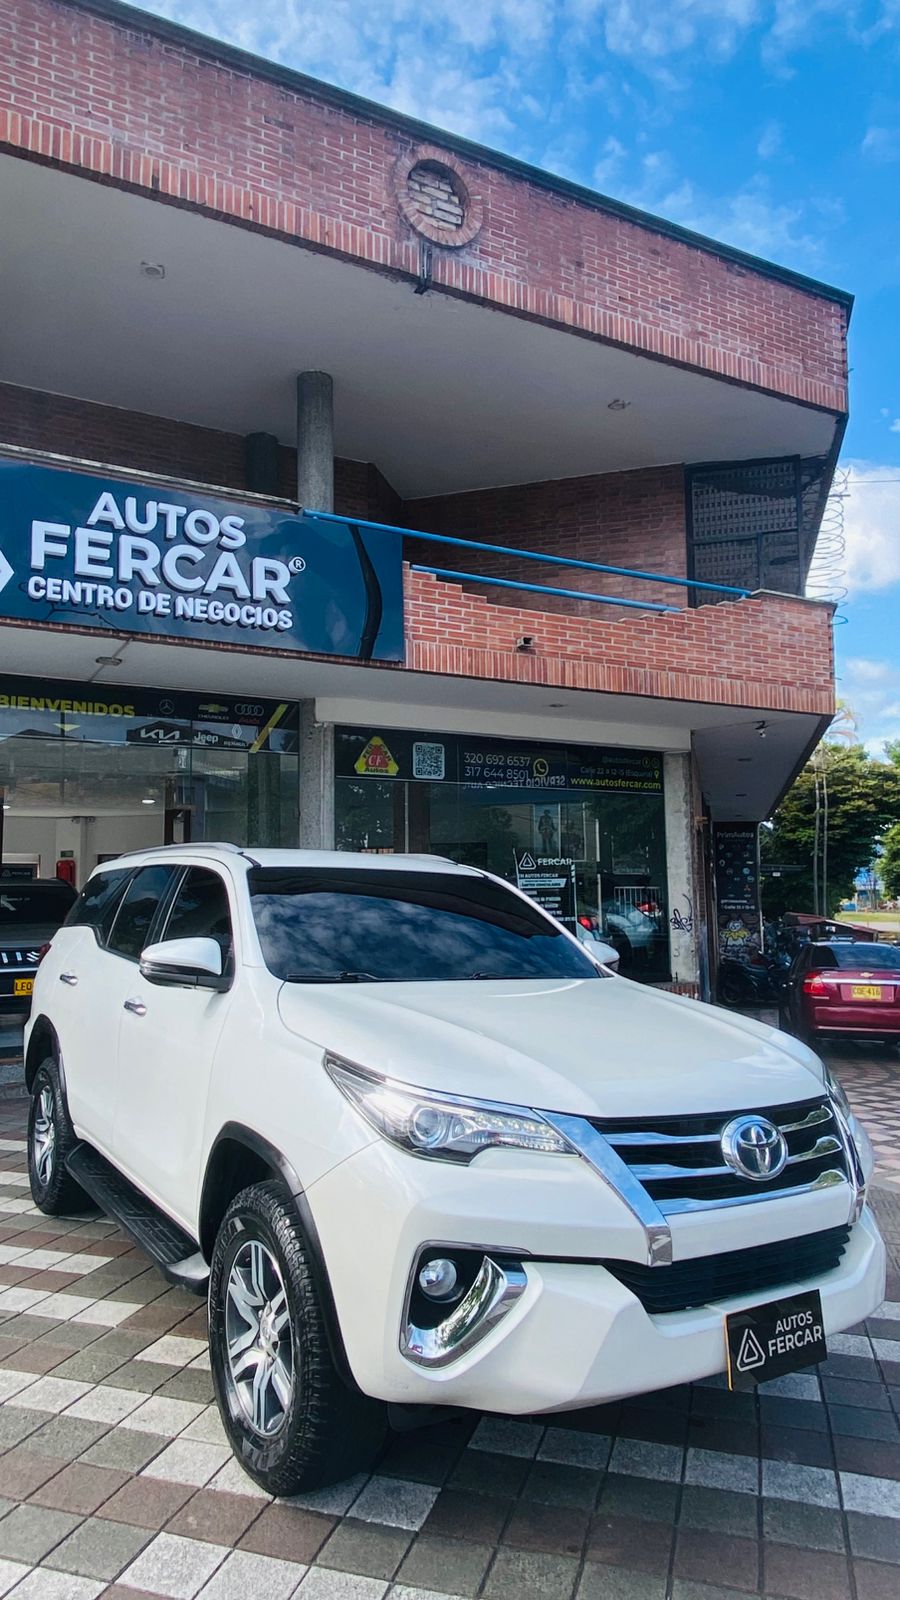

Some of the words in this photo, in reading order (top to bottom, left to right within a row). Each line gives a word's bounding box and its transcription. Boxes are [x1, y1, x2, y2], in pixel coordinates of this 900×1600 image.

[87, 491, 247, 550] AUTOS
[27, 575, 133, 609] CENTRO
[138, 590, 171, 614] DE
[175, 596, 293, 631] NEGOCIOS
[0, 694, 136, 719] BIENVENIDOS
[140, 728, 180, 740] KIA
[193, 731, 219, 744] Jeep
[463, 752, 483, 764] 320
[485, 754, 505, 766] 692
[507, 755, 531, 767] 6537
[464, 765, 481, 777] 317
[483, 767, 504, 778] 644
[506, 768, 529, 781] 8501
[570, 777, 661, 790] www.autosfercar.com
[537, 857, 572, 866] FERCAR
[775, 1311, 813, 1335] AUTOS
[768, 1325, 822, 1357] FERCAR
